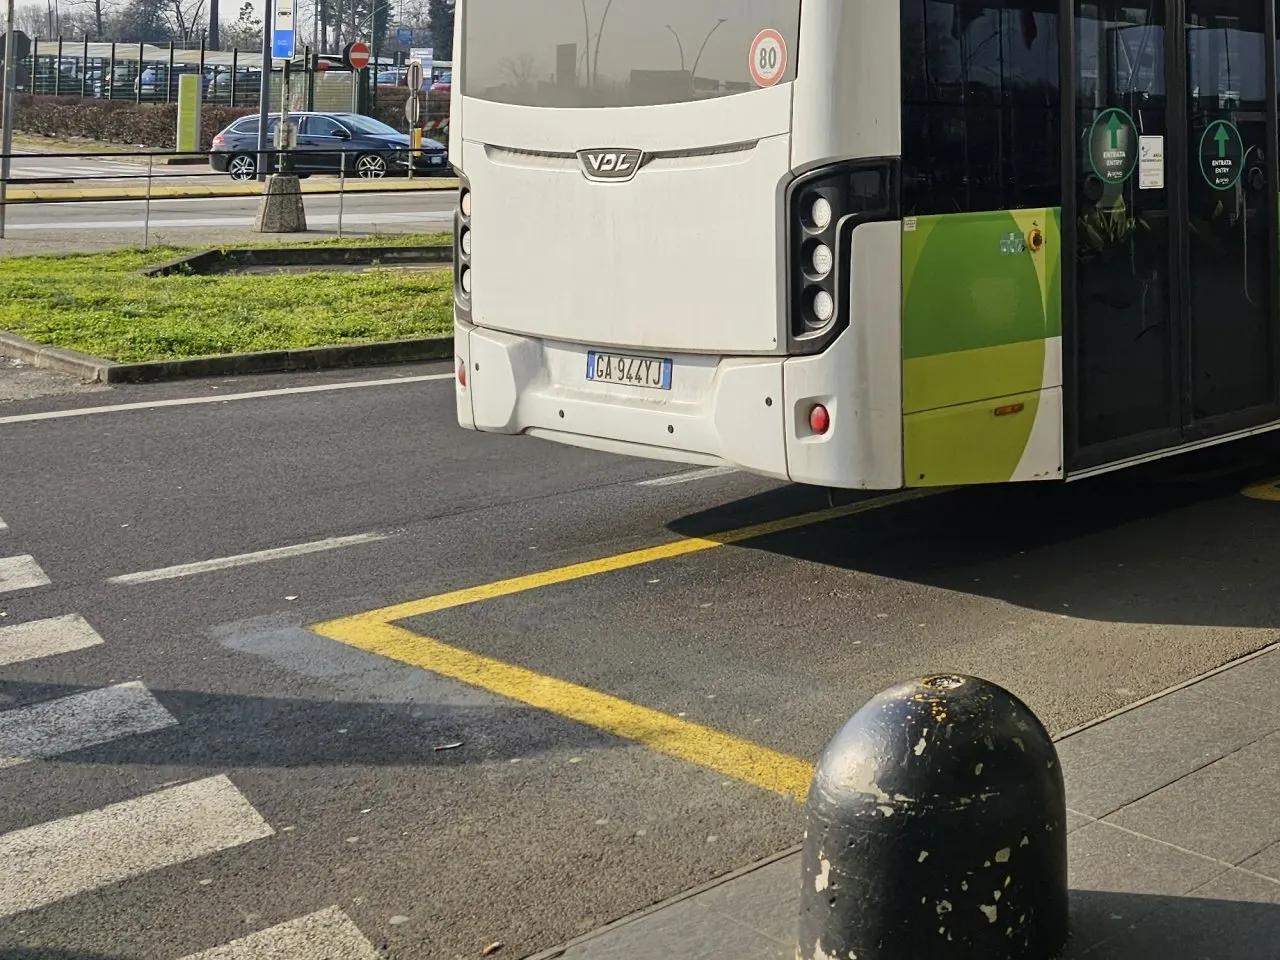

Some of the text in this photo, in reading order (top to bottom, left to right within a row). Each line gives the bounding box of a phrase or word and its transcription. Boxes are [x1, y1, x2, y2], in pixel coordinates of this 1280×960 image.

[760, 46, 776, 69] 80
[587, 152, 632, 172] VDL
[596, 355, 661, 386] GA 944YJ
